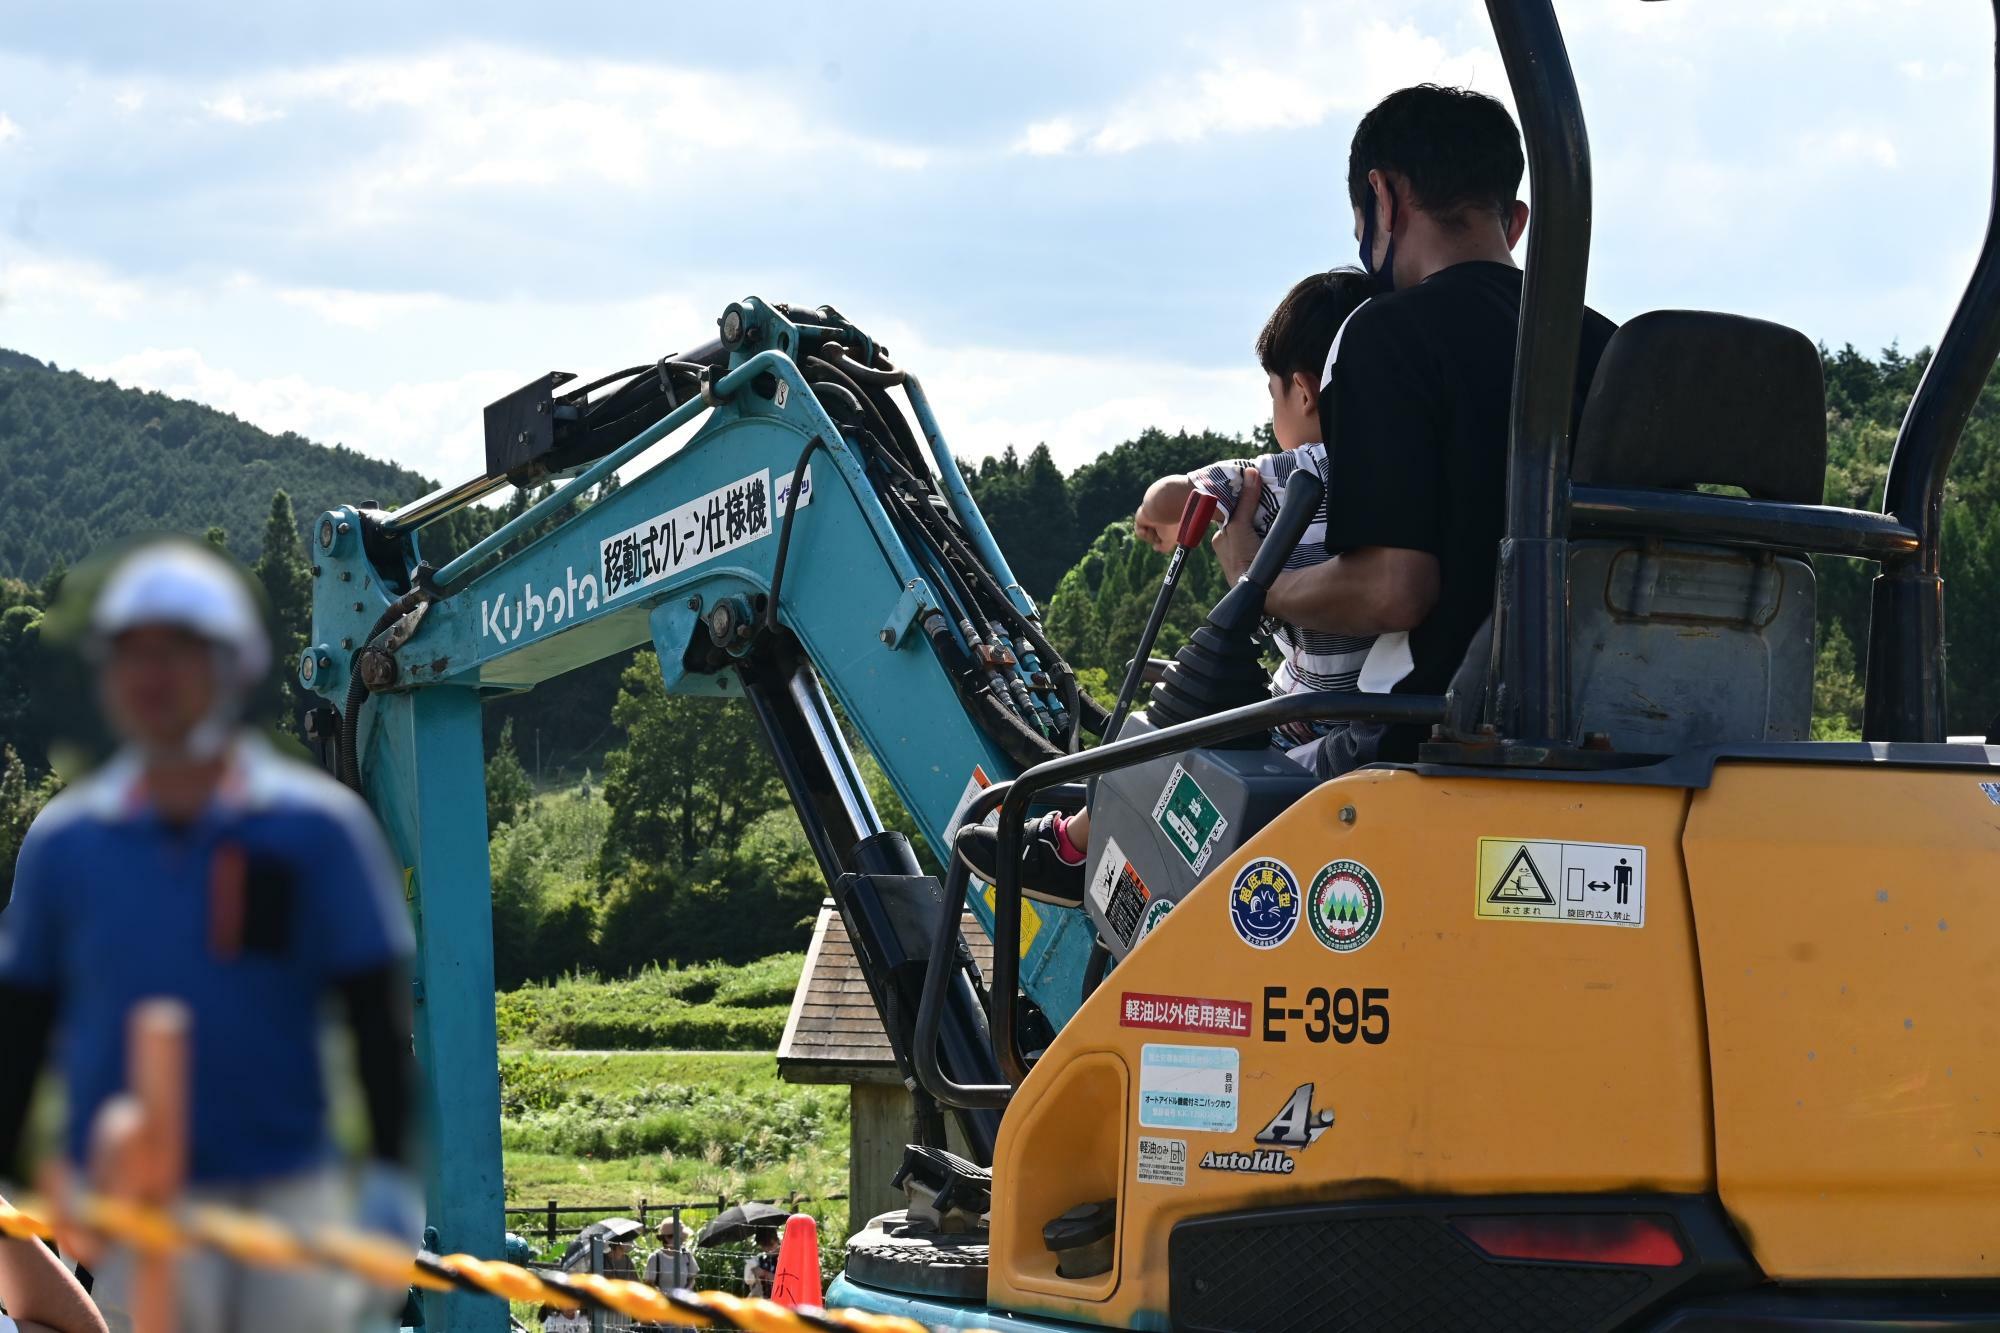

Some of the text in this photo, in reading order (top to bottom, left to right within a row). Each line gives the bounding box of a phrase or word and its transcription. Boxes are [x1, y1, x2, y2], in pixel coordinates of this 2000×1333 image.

[604, 477, 767, 597] 移動式クレーン仕様機
[481, 566, 599, 645] Kubota
[1239, 870, 1291, 908] 超低騒音型
[1502, 906, 1541, 916] はさまれ
[1567, 908, 1631, 921] 旋回内立入禁止
[1125, 999, 1247, 1030] 軽油以外使用禁止
[1263, 986, 1390, 1045] E-395
[1145, 1096, 1231, 1109] オートアイドル機能付ミニバックホウ
[1140, 1141, 1169, 1154] 軽油のみ
[1200, 1150, 1294, 1173] AutoIdle
